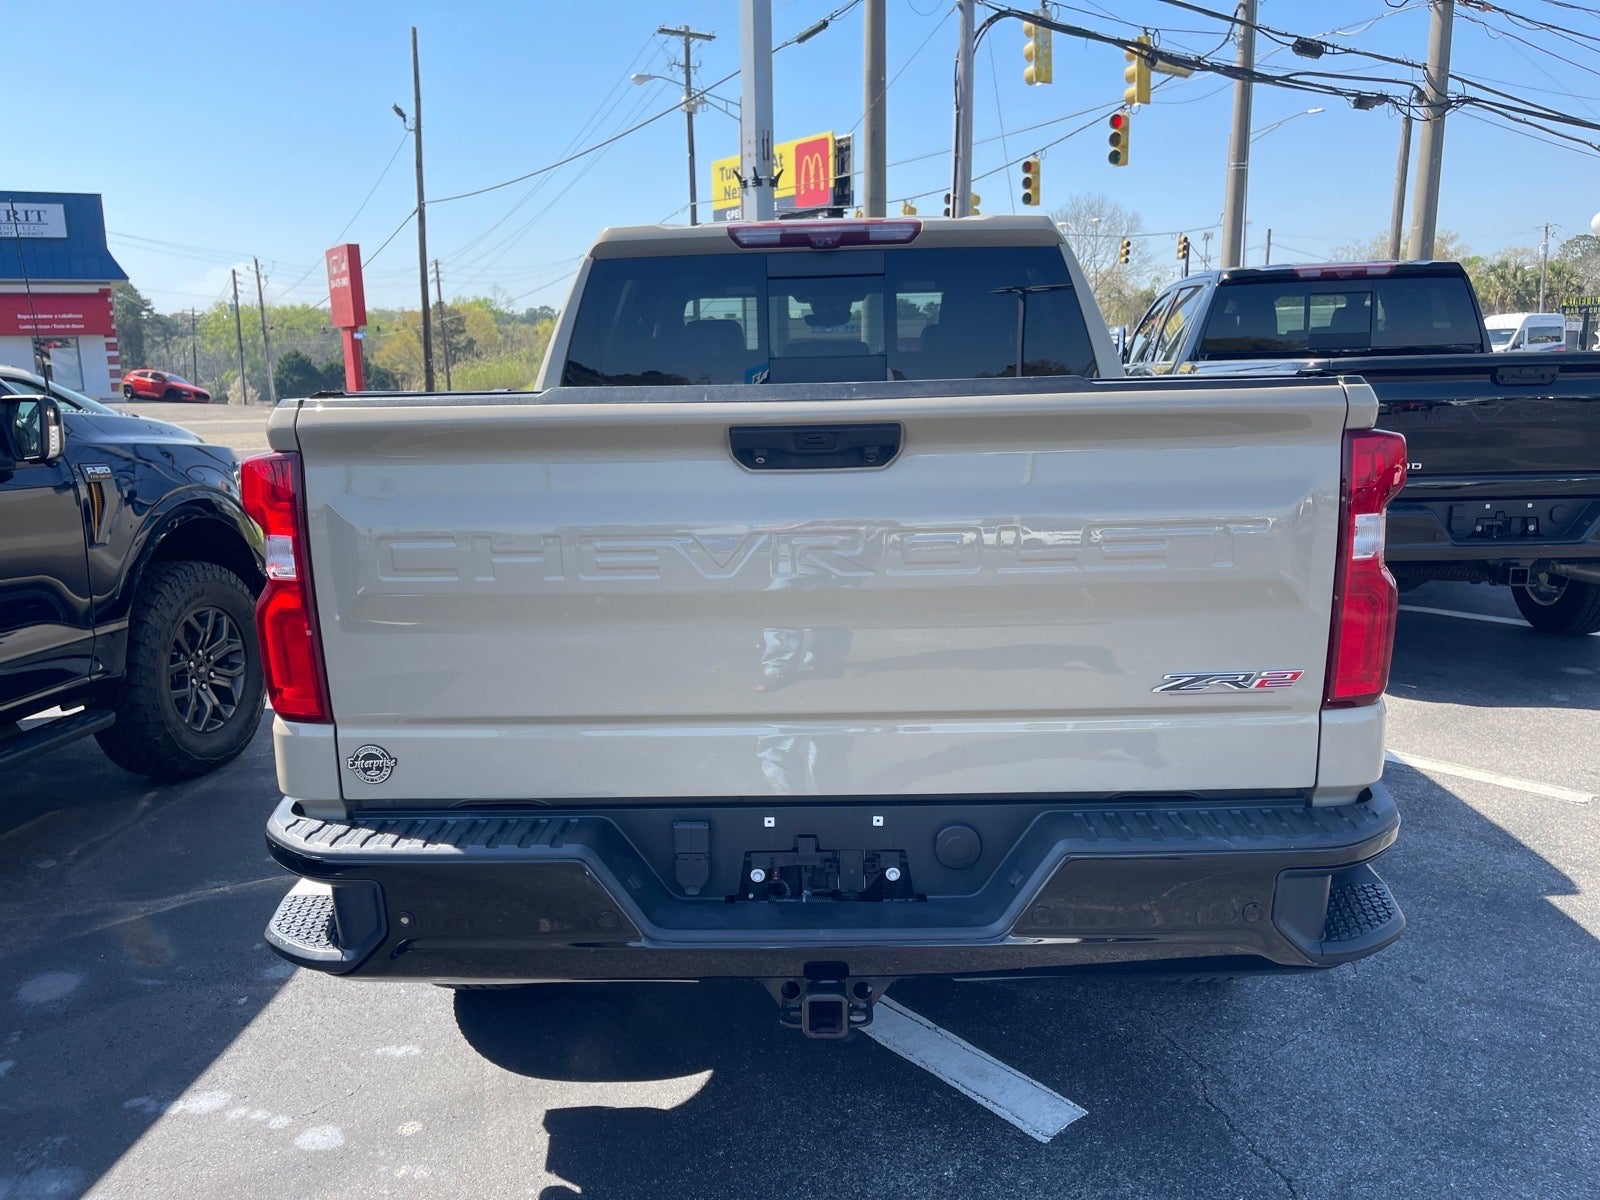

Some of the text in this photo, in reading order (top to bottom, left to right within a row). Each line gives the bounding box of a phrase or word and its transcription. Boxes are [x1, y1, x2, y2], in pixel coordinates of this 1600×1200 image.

[725, 209, 741, 220] OPE
[376, 517, 1272, 582] CHEVROLET
[1151, 669, 1304, 693] ZR2
[347, 757, 397, 771] Enterprise
